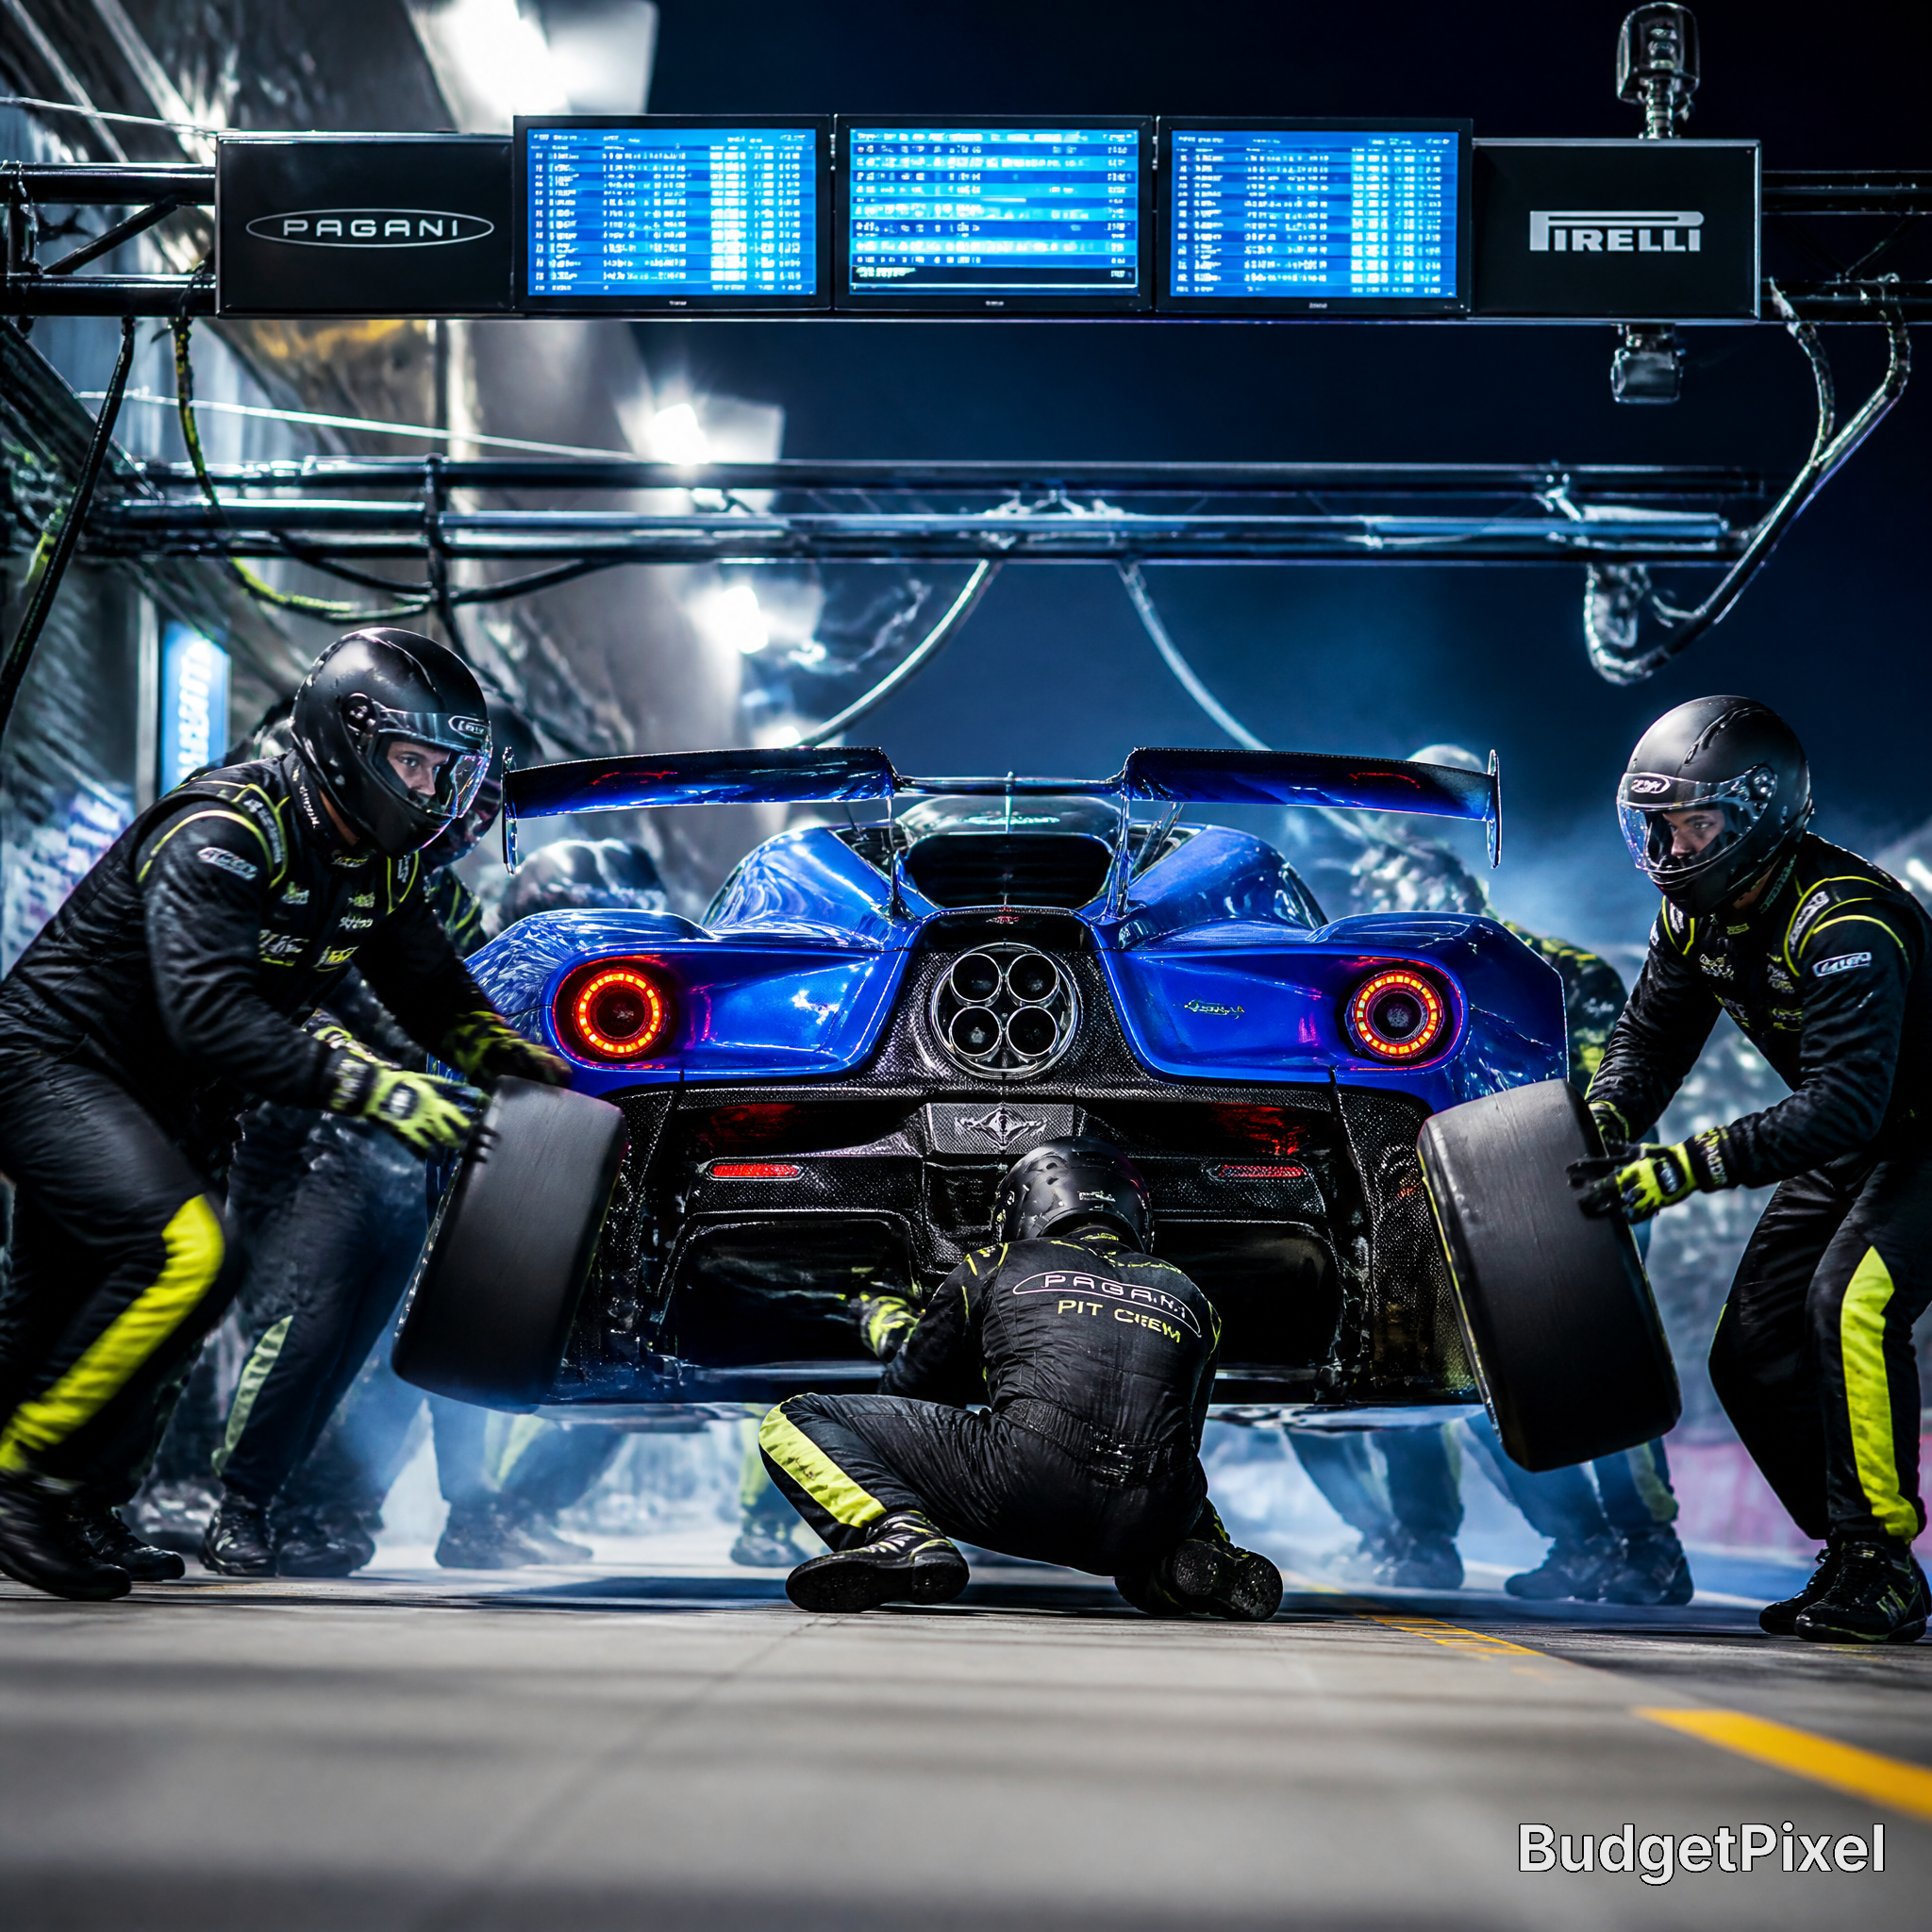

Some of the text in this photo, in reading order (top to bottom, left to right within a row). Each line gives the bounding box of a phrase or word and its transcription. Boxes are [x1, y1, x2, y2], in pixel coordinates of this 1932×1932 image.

[284, 219, 458, 237] PAGANI
[1529, 210, 1705, 252] PIRELLI
[1058, 1299, 1104, 1316] PIT
